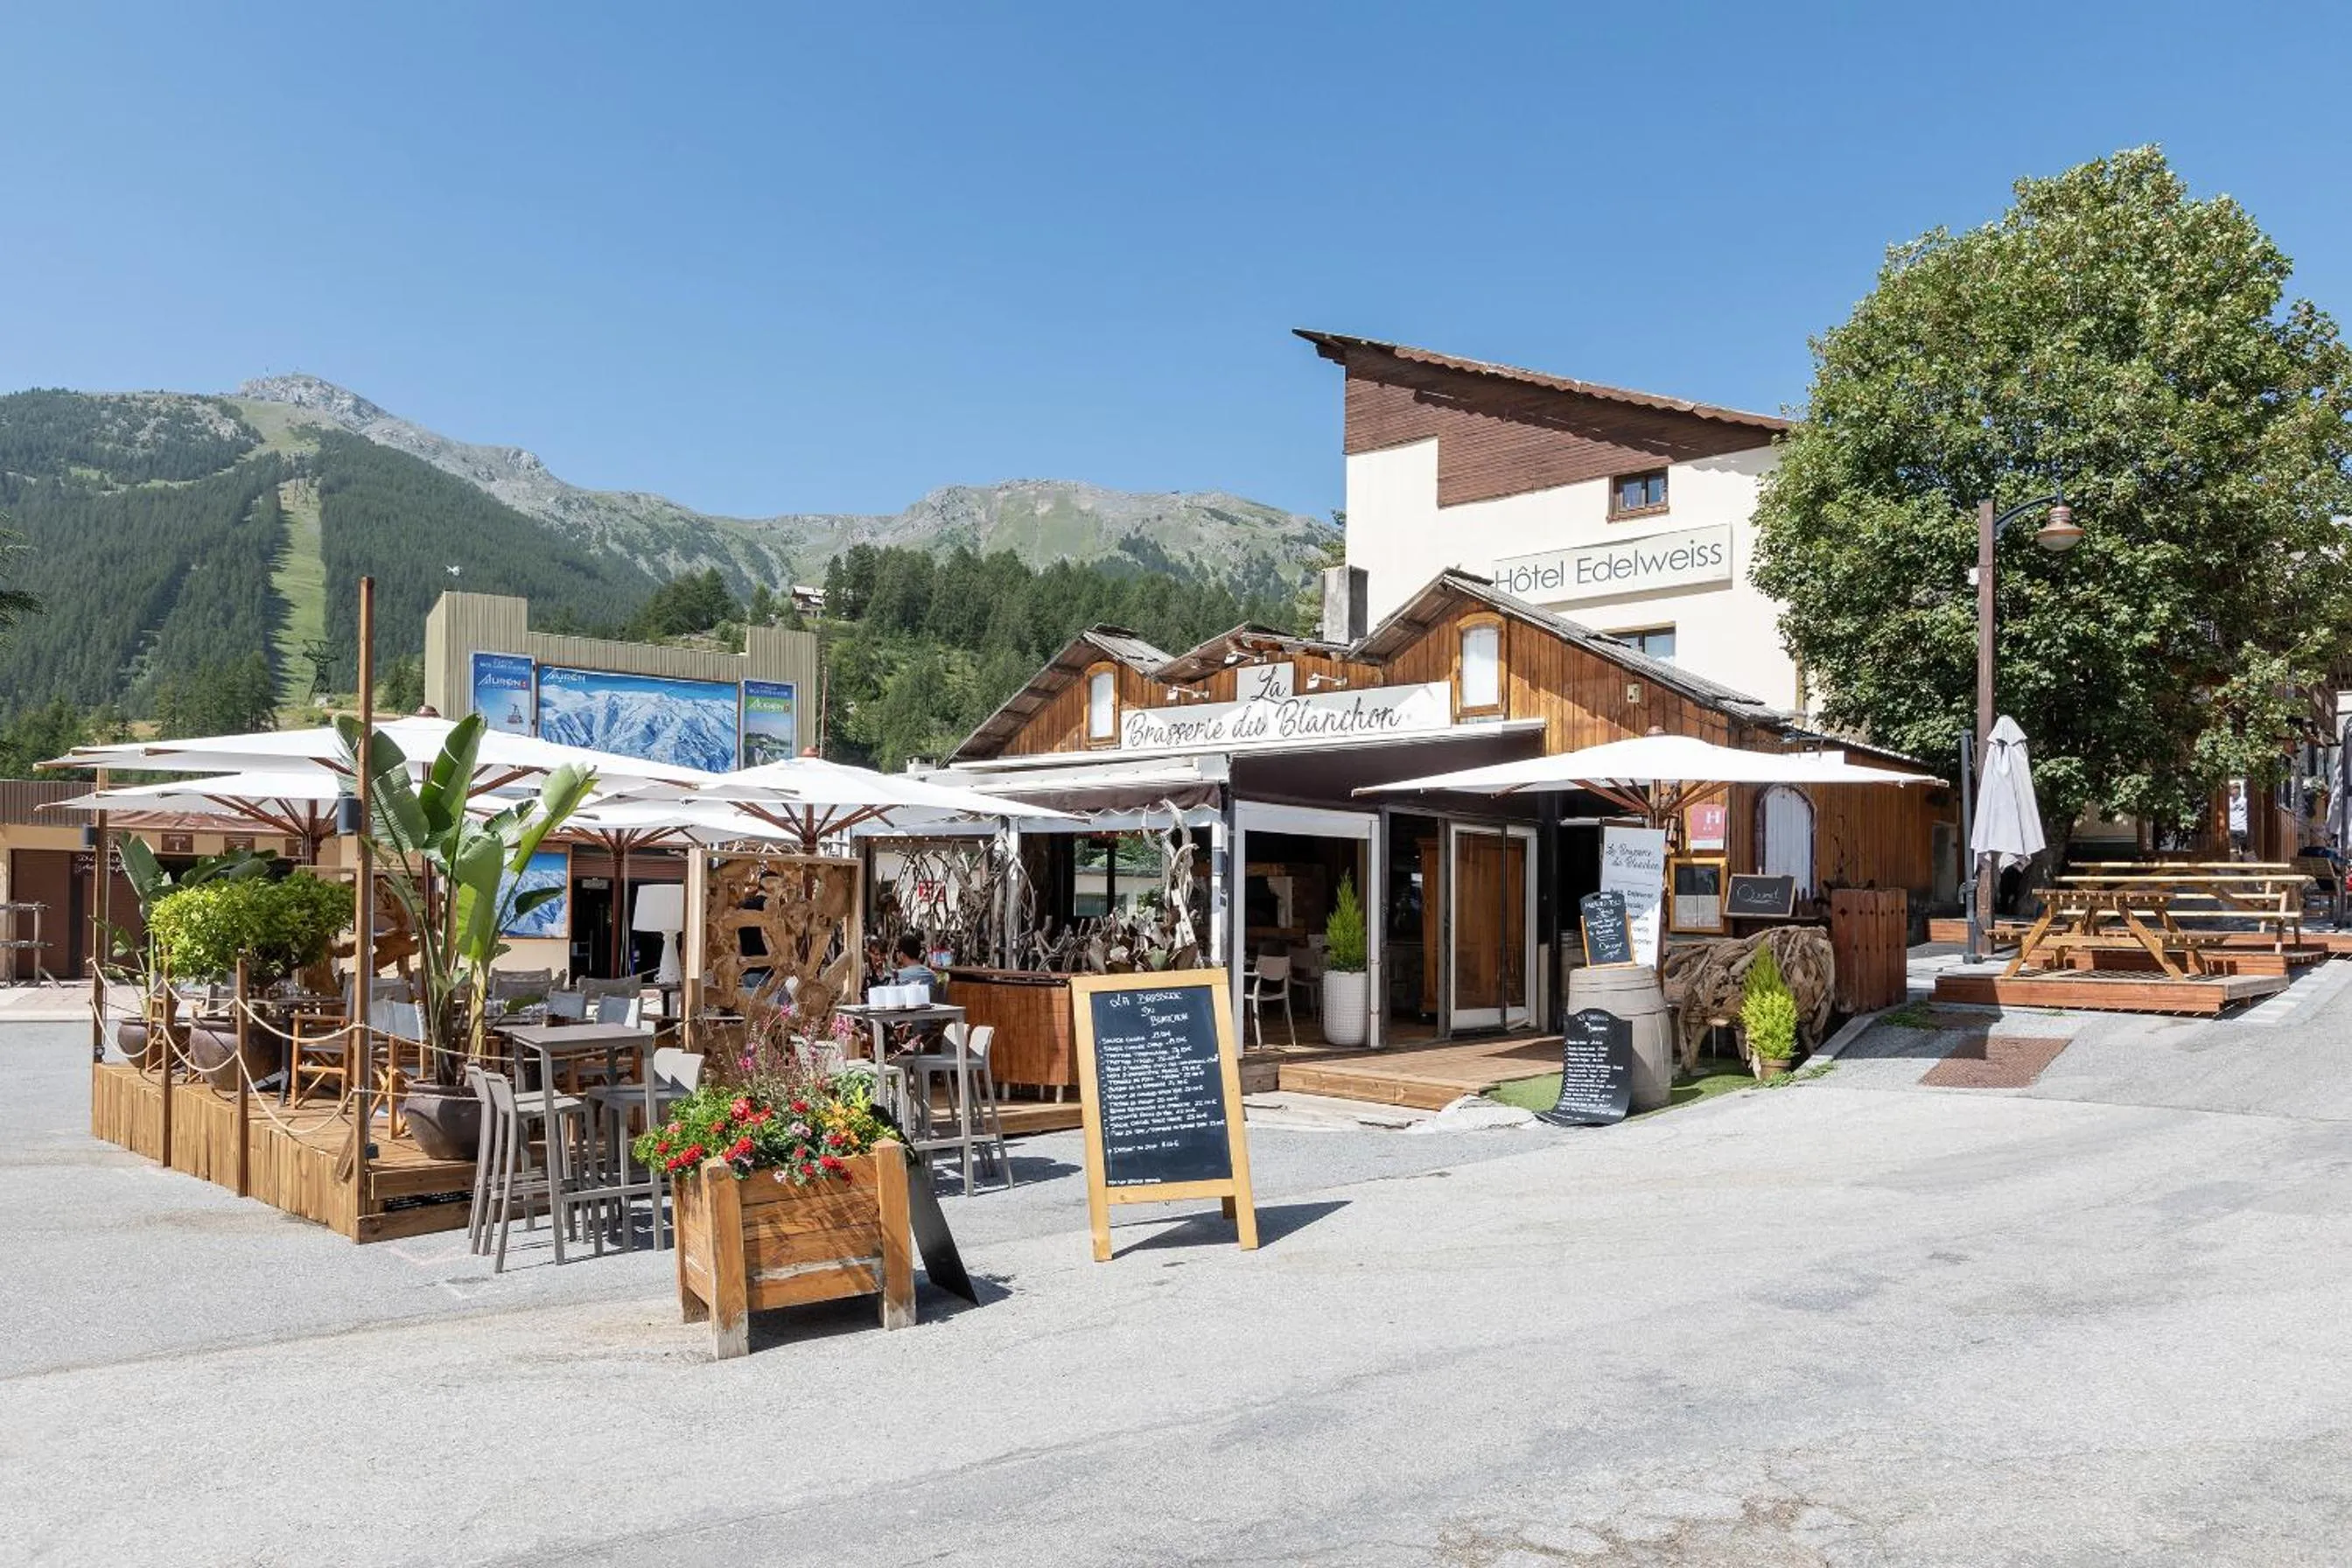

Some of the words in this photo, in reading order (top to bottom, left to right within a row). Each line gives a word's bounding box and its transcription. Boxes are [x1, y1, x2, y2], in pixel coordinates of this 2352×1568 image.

[1494, 560, 1564, 593] Hôtel
[1577, 539, 1723, 584] Edelweiss
[1250, 666, 1287, 704] La
[1126, 712, 1226, 747] Brasserie
[1232, 705, 1268, 739] du
[1274, 696, 1402, 738] Blanchon
[1705, 810, 1721, 824] H
